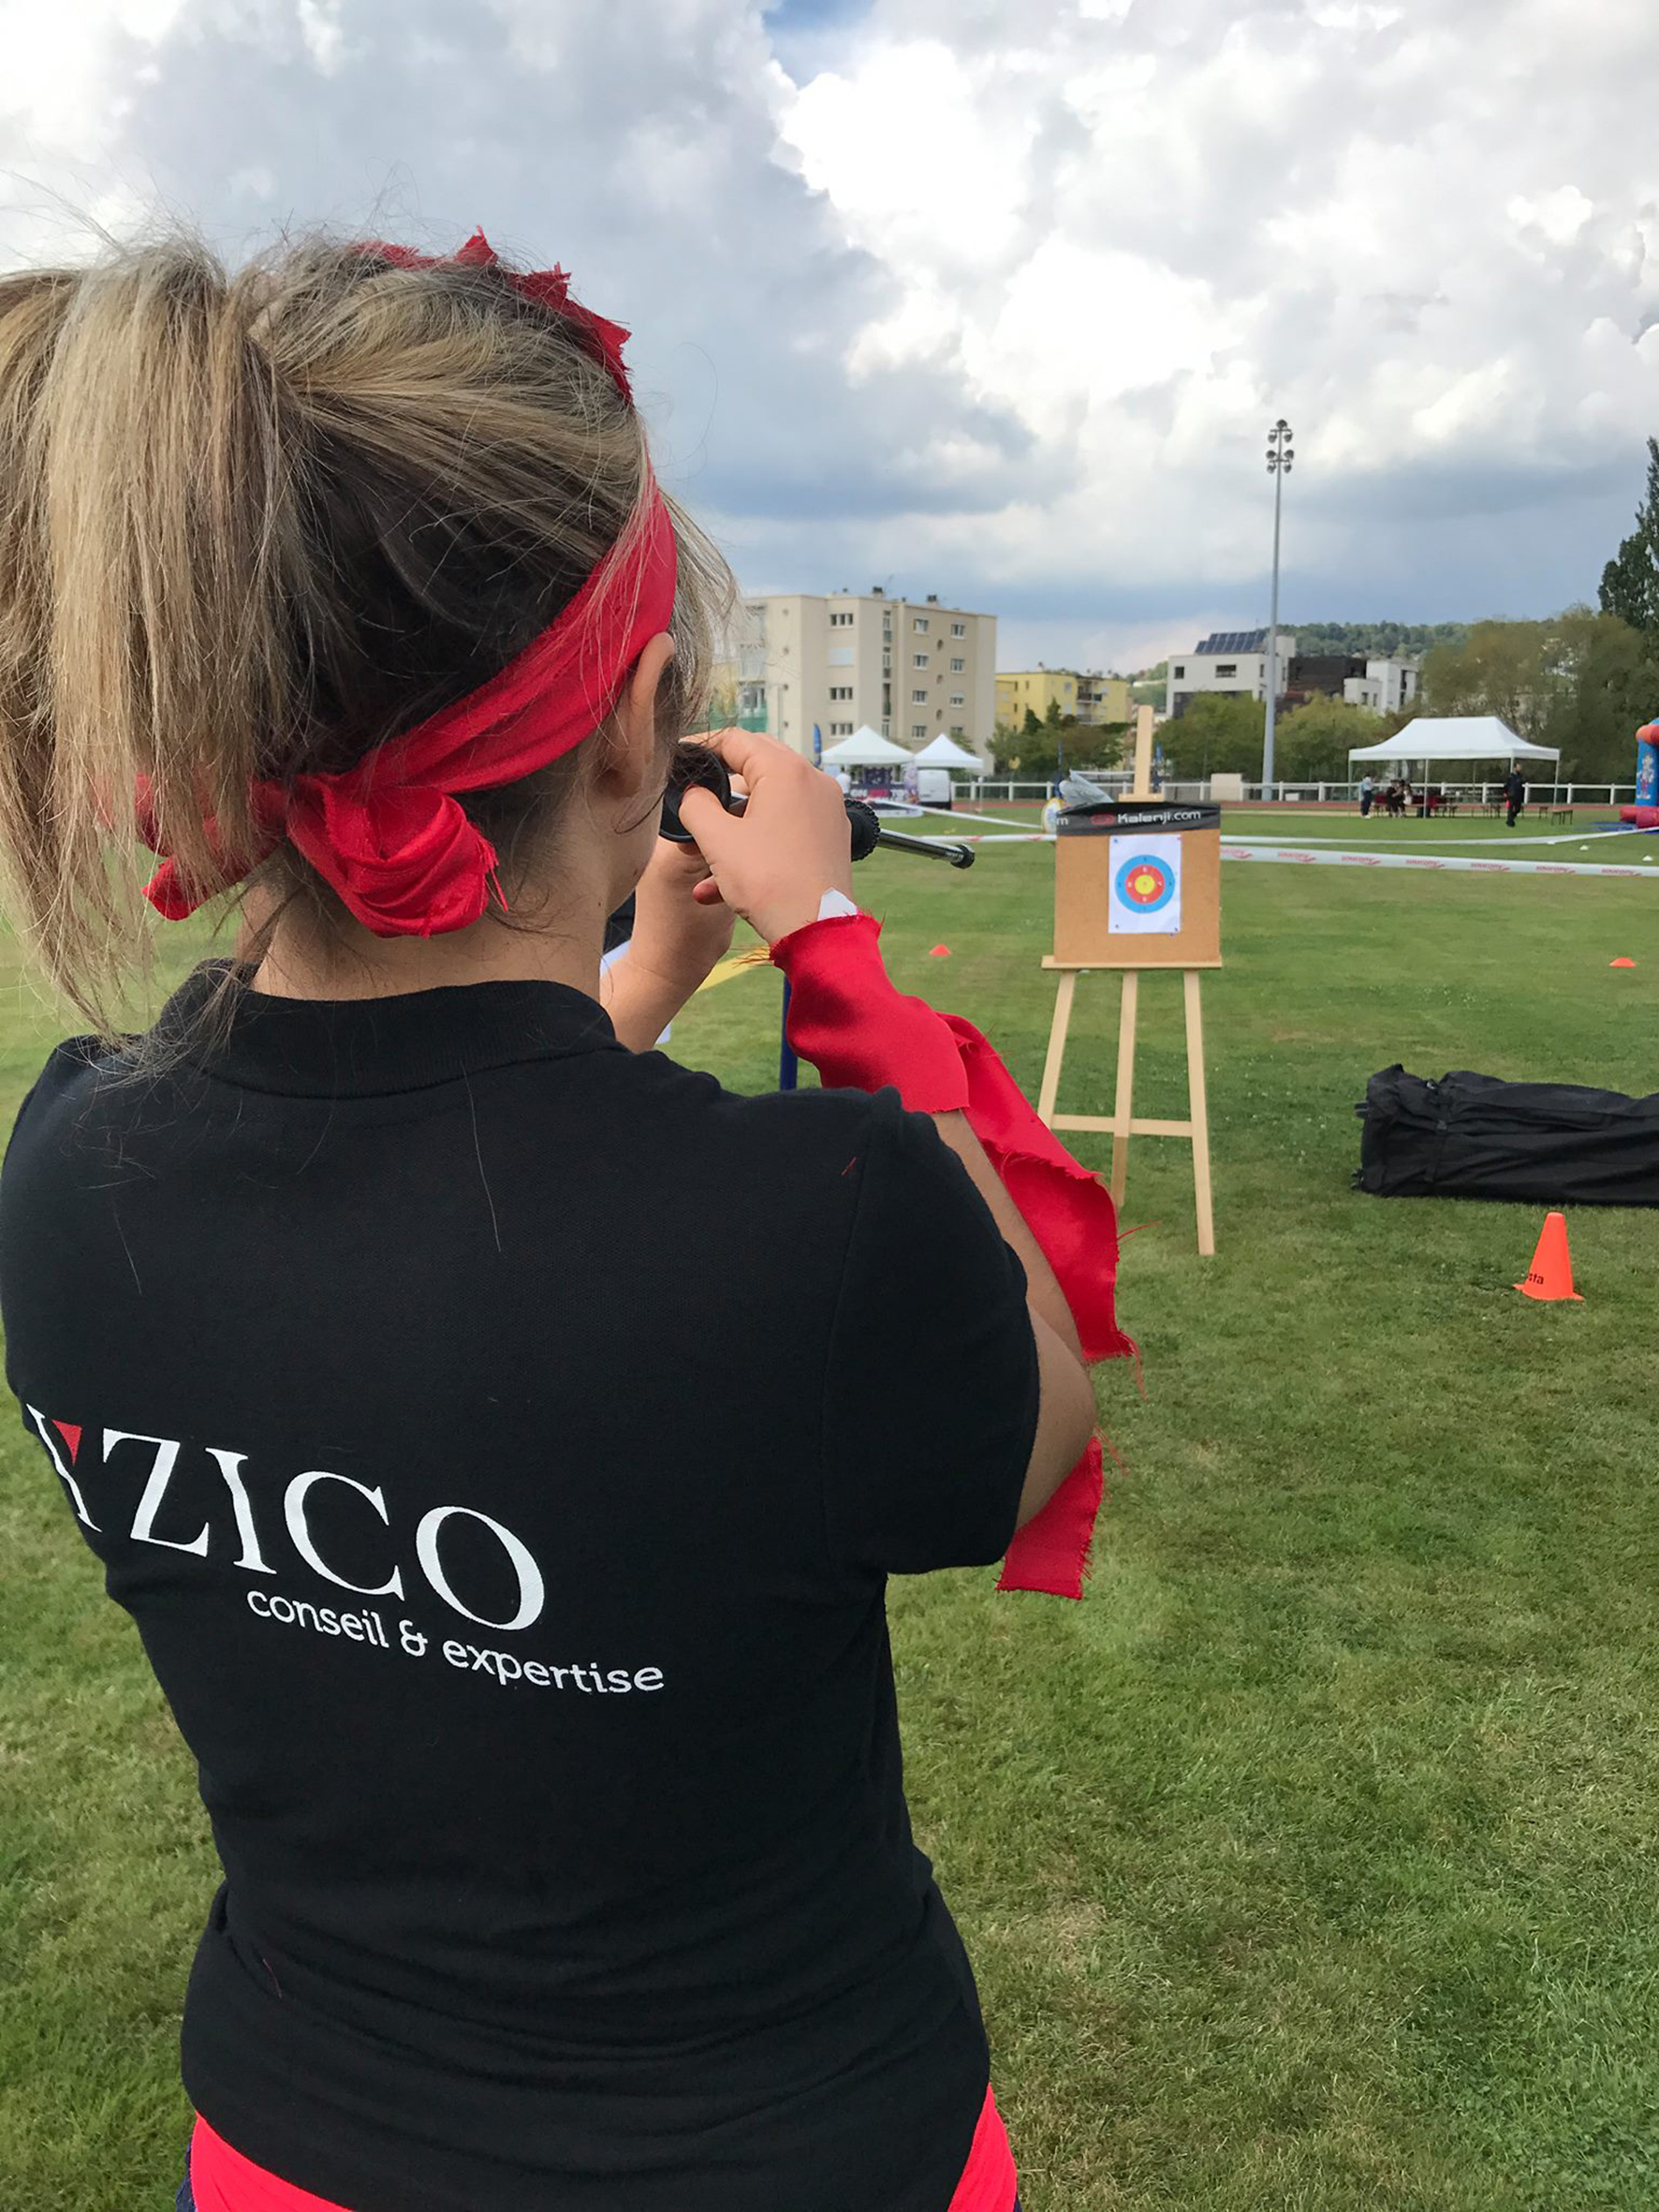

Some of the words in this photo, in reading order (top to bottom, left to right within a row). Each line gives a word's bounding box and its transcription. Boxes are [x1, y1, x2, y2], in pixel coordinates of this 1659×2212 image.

[1117, 811, 1201, 825] Kalenji.com
[26, 1403, 545, 1630] YZICO
[246, 1589, 389, 1648] conseil
[400, 1619, 428, 1657] &
[443, 1639, 665, 1695] expertise
